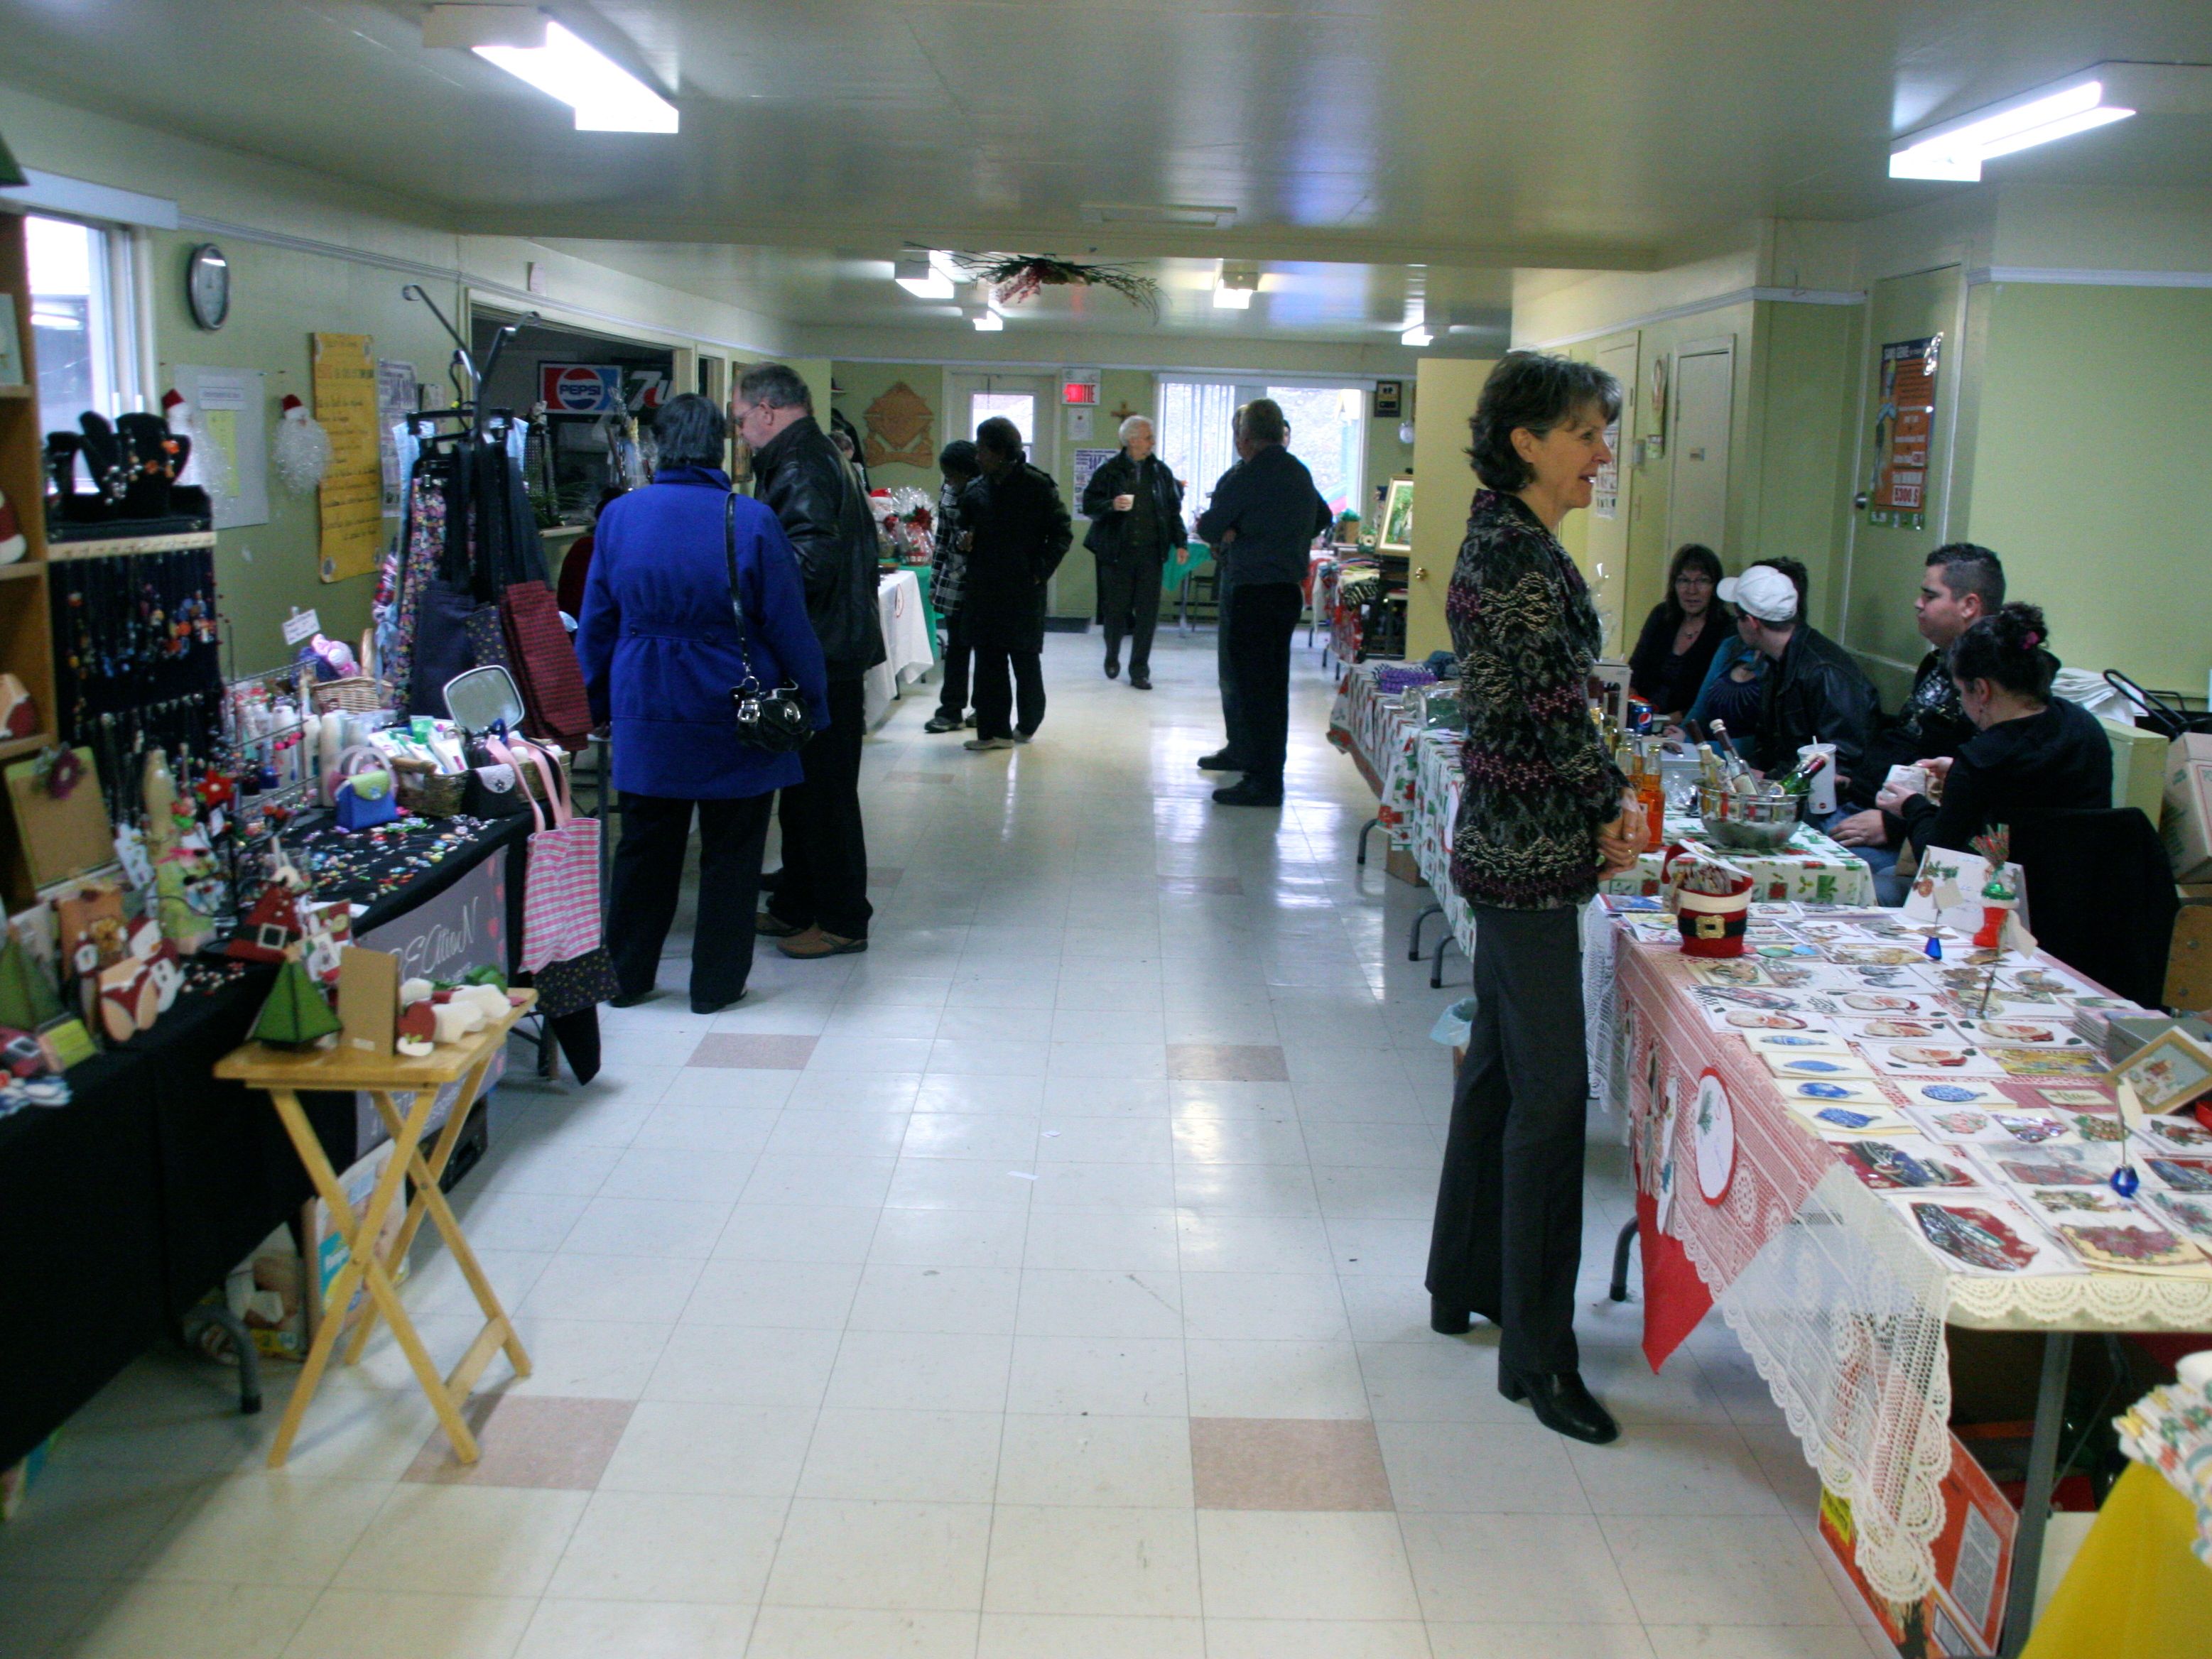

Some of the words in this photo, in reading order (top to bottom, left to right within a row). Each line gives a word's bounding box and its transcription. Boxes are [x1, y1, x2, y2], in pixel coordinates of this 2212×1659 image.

[559, 384, 601, 396] PEPSI
[627, 370, 676, 412] 7U
[1066, 384, 1095, 403] STIE
